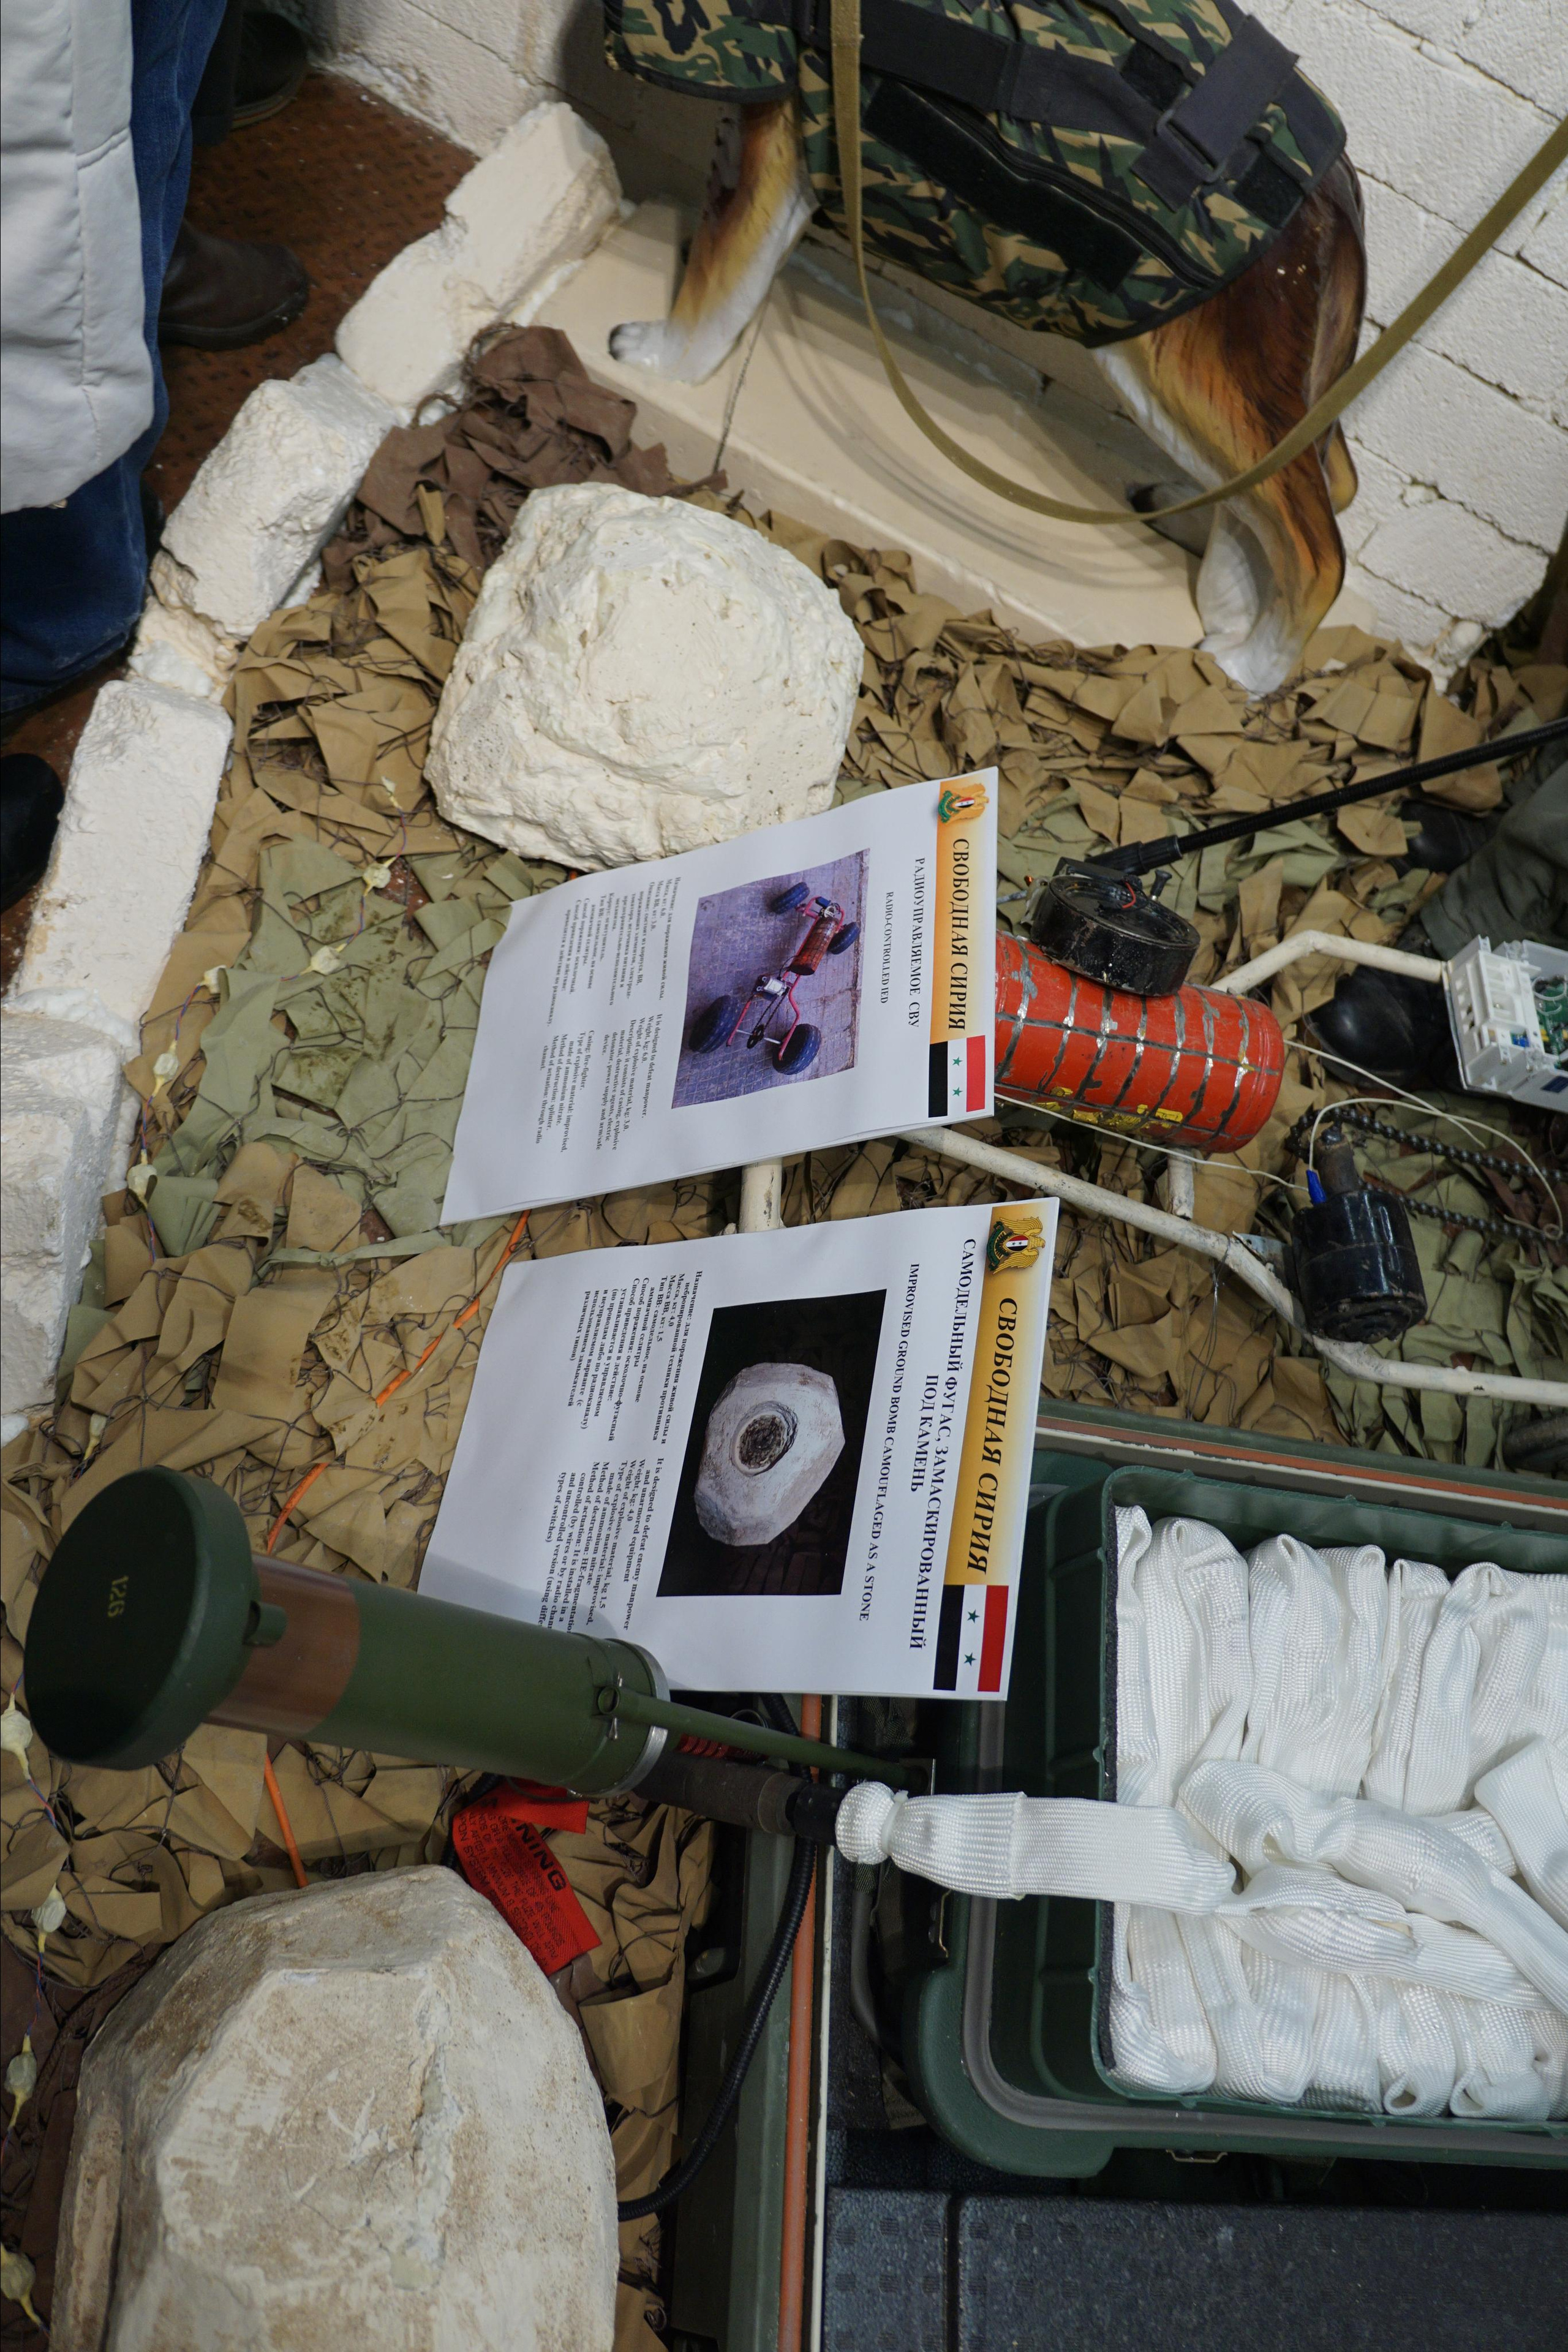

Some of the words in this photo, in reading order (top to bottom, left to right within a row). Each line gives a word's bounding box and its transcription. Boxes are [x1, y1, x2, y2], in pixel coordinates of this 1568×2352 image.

[948, 838, 970, 956] СВОБОДНАЯ
[881, 891, 894, 986] RADIO-CONTROLLED
[909, 858, 925, 996] РАДИОУПРАВЛЯЕМОЕ
[880, 987, 889, 1004] IED
[908, 1001, 921, 1028] СВУ
[948, 962, 968, 1030] СИРИЯ
[628, 1277, 641, 1306] Способ
[638, 1276, 650, 1306] Способ
[665, 1275, 677, 1300] Масса
[900, 1264, 920, 1338] IMPROVISED
[946, 1238, 977, 1372] САМОДЕЛЬНЫЙ
[576, 1290, 592, 1334] различных
[580, 1289, 600, 1353] использованием
[587, 1295, 607, 1357] неуправляемом
[601, 1302, 615, 1340] проводам
[608, 1287, 628, 1354] устанавливается
[641, 1286, 655, 1332] аммиачной
[671, 1281, 690, 1353] небронированной
[569, 1335, 581, 1362] типов)
[617, 1307, 633, 1354] приведения
[597, 1341, 606, 1361] либо
[633, 1333, 646, 1368] селитры
[673, 1338, 688, 1384] поражения
[892, 1340, 909, 1393] GROUND
[567, 1354, 584, 1407] замыкателей
[579, 1358, 592, 1396] варианте
[594, 1362, 611, 1417] управляемом
[634, 1374, 645, 1403] основе
[663, 1354, 676, 1389] техники
[981, 1297, 1018, 1464] СВОБОДНАЯ
[580, 1373, 598, 1430] радиоканалу)
[608, 1355, 631, 1442] осколочно-фугасный
[667, 1385, 678, 1412] живой
[919, 1374, 940, 1412] ПОД
[934, 1376, 958, 1442] ФУГАС,
[652, 1390, 668, 1441] противника
[662, 1414, 671, 1437] силы
[886, 1396, 901, 1434] BOMB
[617, 1460, 628, 1482] Type
[910, 1415, 933, 1493] КАМЕНЬ
[557, 1471, 567, 1493] types
[572, 1472, 586, 1514] controlled
[586, 1461, 601, 1493] Method
[597, 1461, 610, 1493] Method
[605, 1472, 616, 1495] made
[624, 1460, 637, 1490] Weight
[646, 1475, 661, 1512] designed
[871, 1436, 895, 1540] CAMOUFLAGED
[545, 1504, 559, 1543] switches)
[556, 1489, 573, 1542] uncontrolled
[592, 1506, 608, 1555] ammonium
[606, 1493, 619, 1532] explosive
[613, 1501, 627, 1540] explosive
[633, 1487, 647, 1535] unarmored
[967, 1472, 999, 1575] СИРИЯ
[564, 1531, 574, 1554] wires
[639, 1524, 651, 1551] defeat
[867, 1542, 879, 1560] AS
[909, 1446, 949, 1649] ЗАМАСКИРОВАННЫЙ
[549, 1544, 561, 1575] version
[586, 1556, 598, 1586] nitrate
[623, 1536, 637, 1583] equipment
[631, 1553, 644, 1582] enemy
[865, 1562, 876, 1572] A
[107, 1575, 129, 1618] 126
[540, 1576, 555, 1604] (using
[551, 1580, 563, 1604] radio
[562, 1567, 576, 1605] installed
[566, 1558, 589, 1635] HE-fragmentatio
[859, 1575, 875, 1621] STONE
[537, 1604, 549, 1627] diffe
[546, 1604, 559, 1630] chan
[623, 1583, 638, 1631] manpower
[514, 1822, 567, 1892] NING
